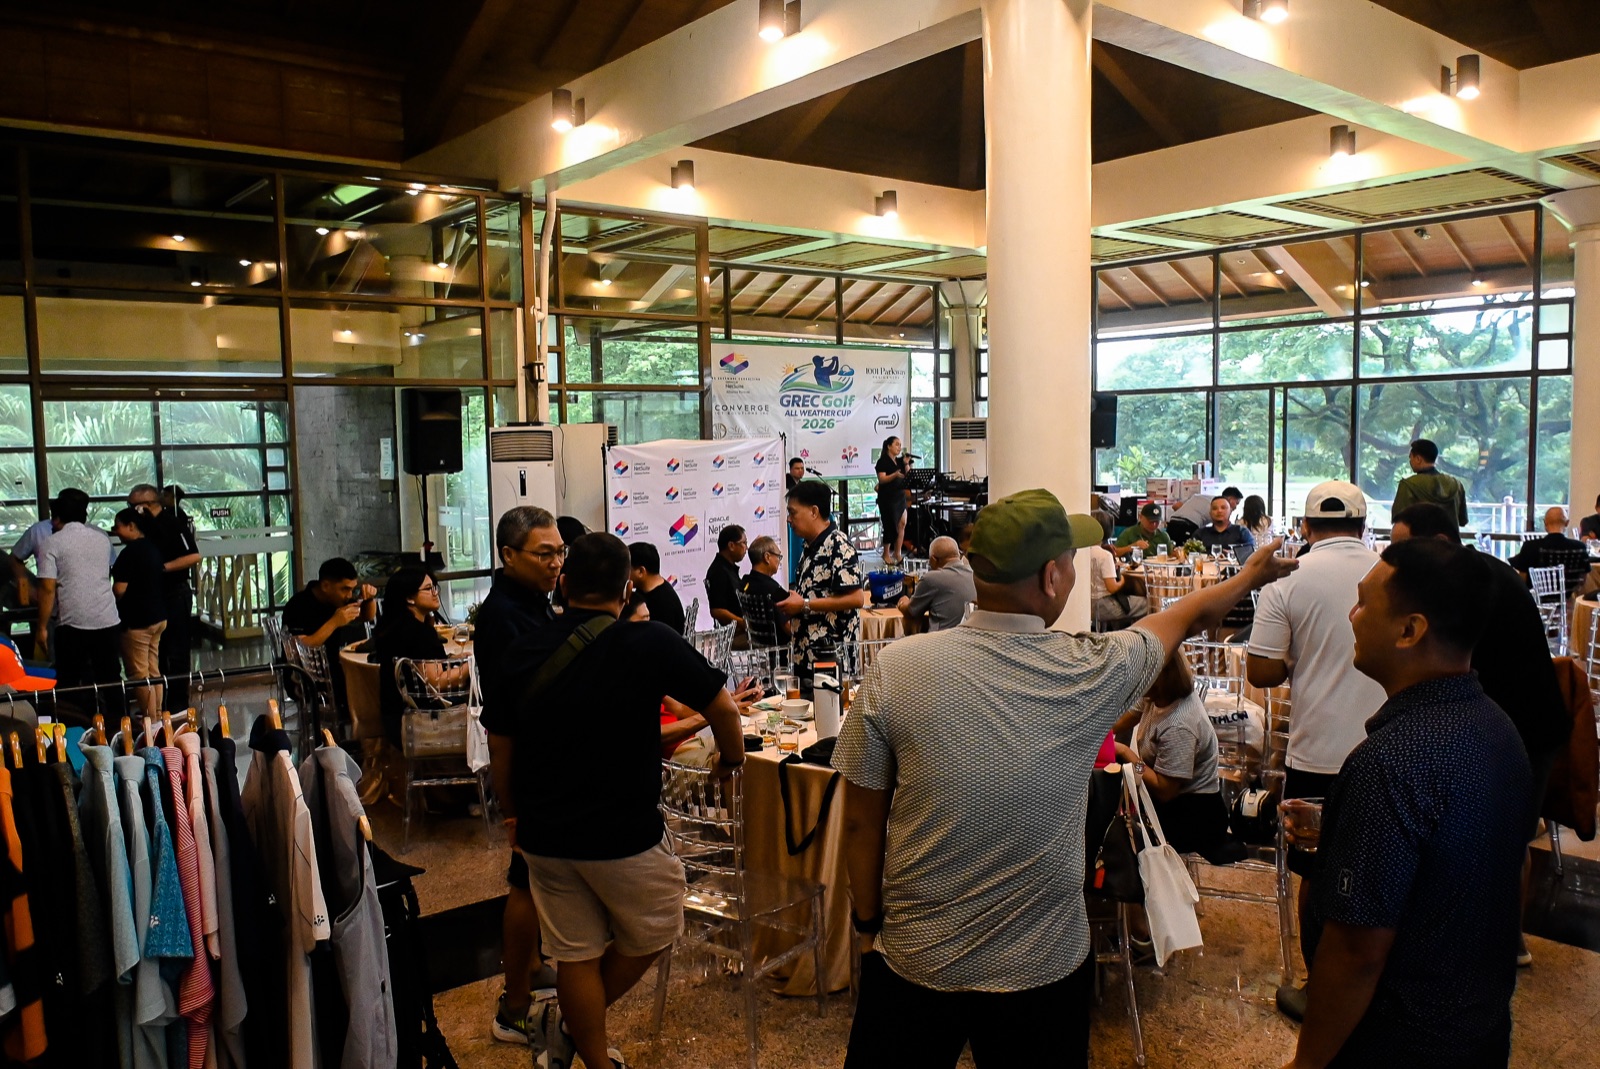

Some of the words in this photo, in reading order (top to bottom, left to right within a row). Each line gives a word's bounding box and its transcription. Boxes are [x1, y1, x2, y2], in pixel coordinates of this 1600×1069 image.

[780, 394, 820, 408] GREC
[822, 395, 855, 408] Golf
[801, 418, 835, 429] 2026
[1208, 711, 1248, 724] THLON
